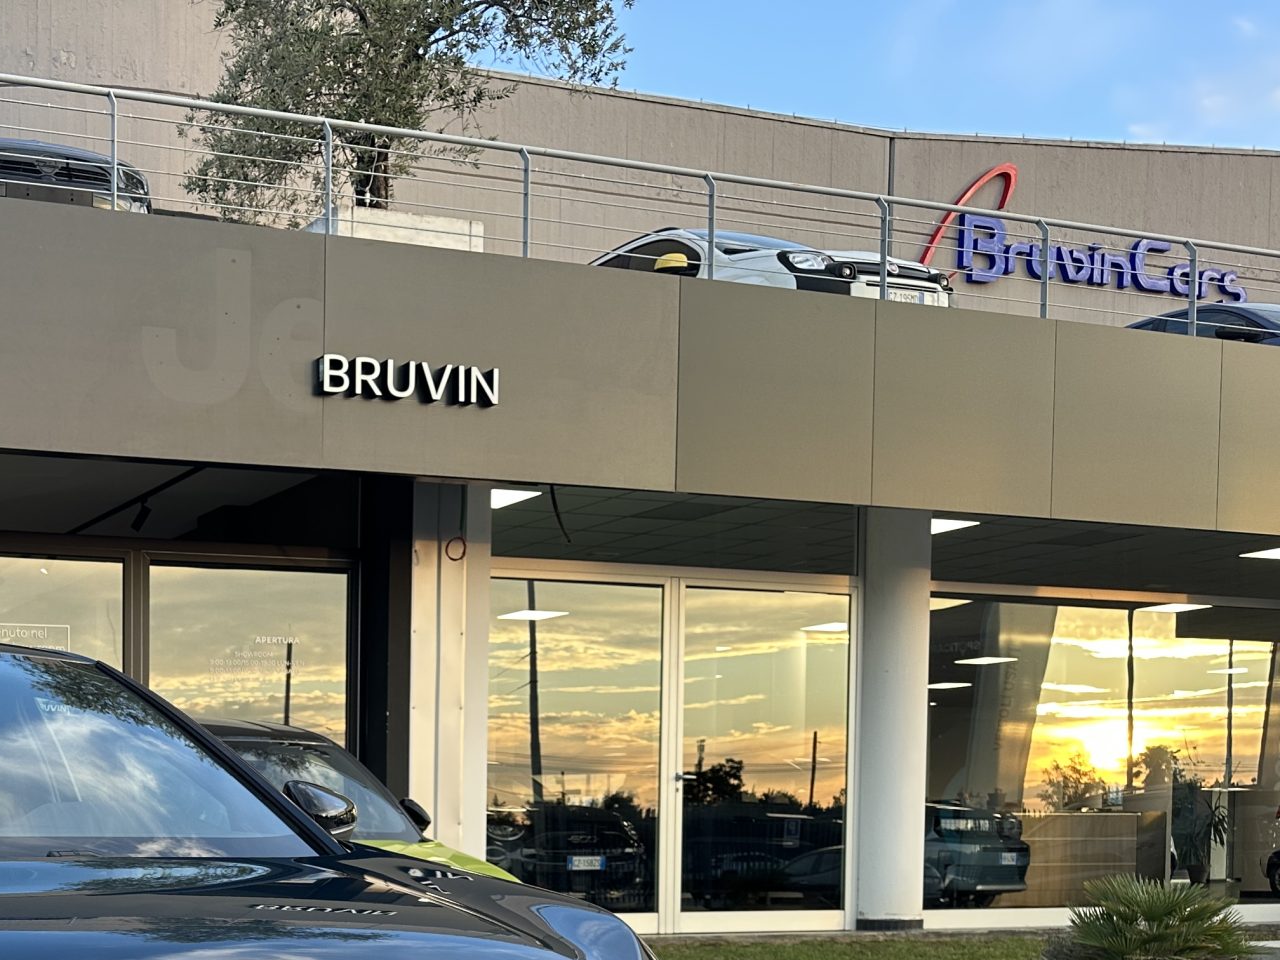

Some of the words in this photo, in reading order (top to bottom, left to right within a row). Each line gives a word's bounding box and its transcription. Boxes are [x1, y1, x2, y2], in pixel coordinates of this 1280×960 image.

[957, 212, 1248, 305] BruvinCars
[322, 353, 500, 406] BRUVIN
[30, 629, 48, 639] nel
[255, 636, 300, 644] APERTURA
